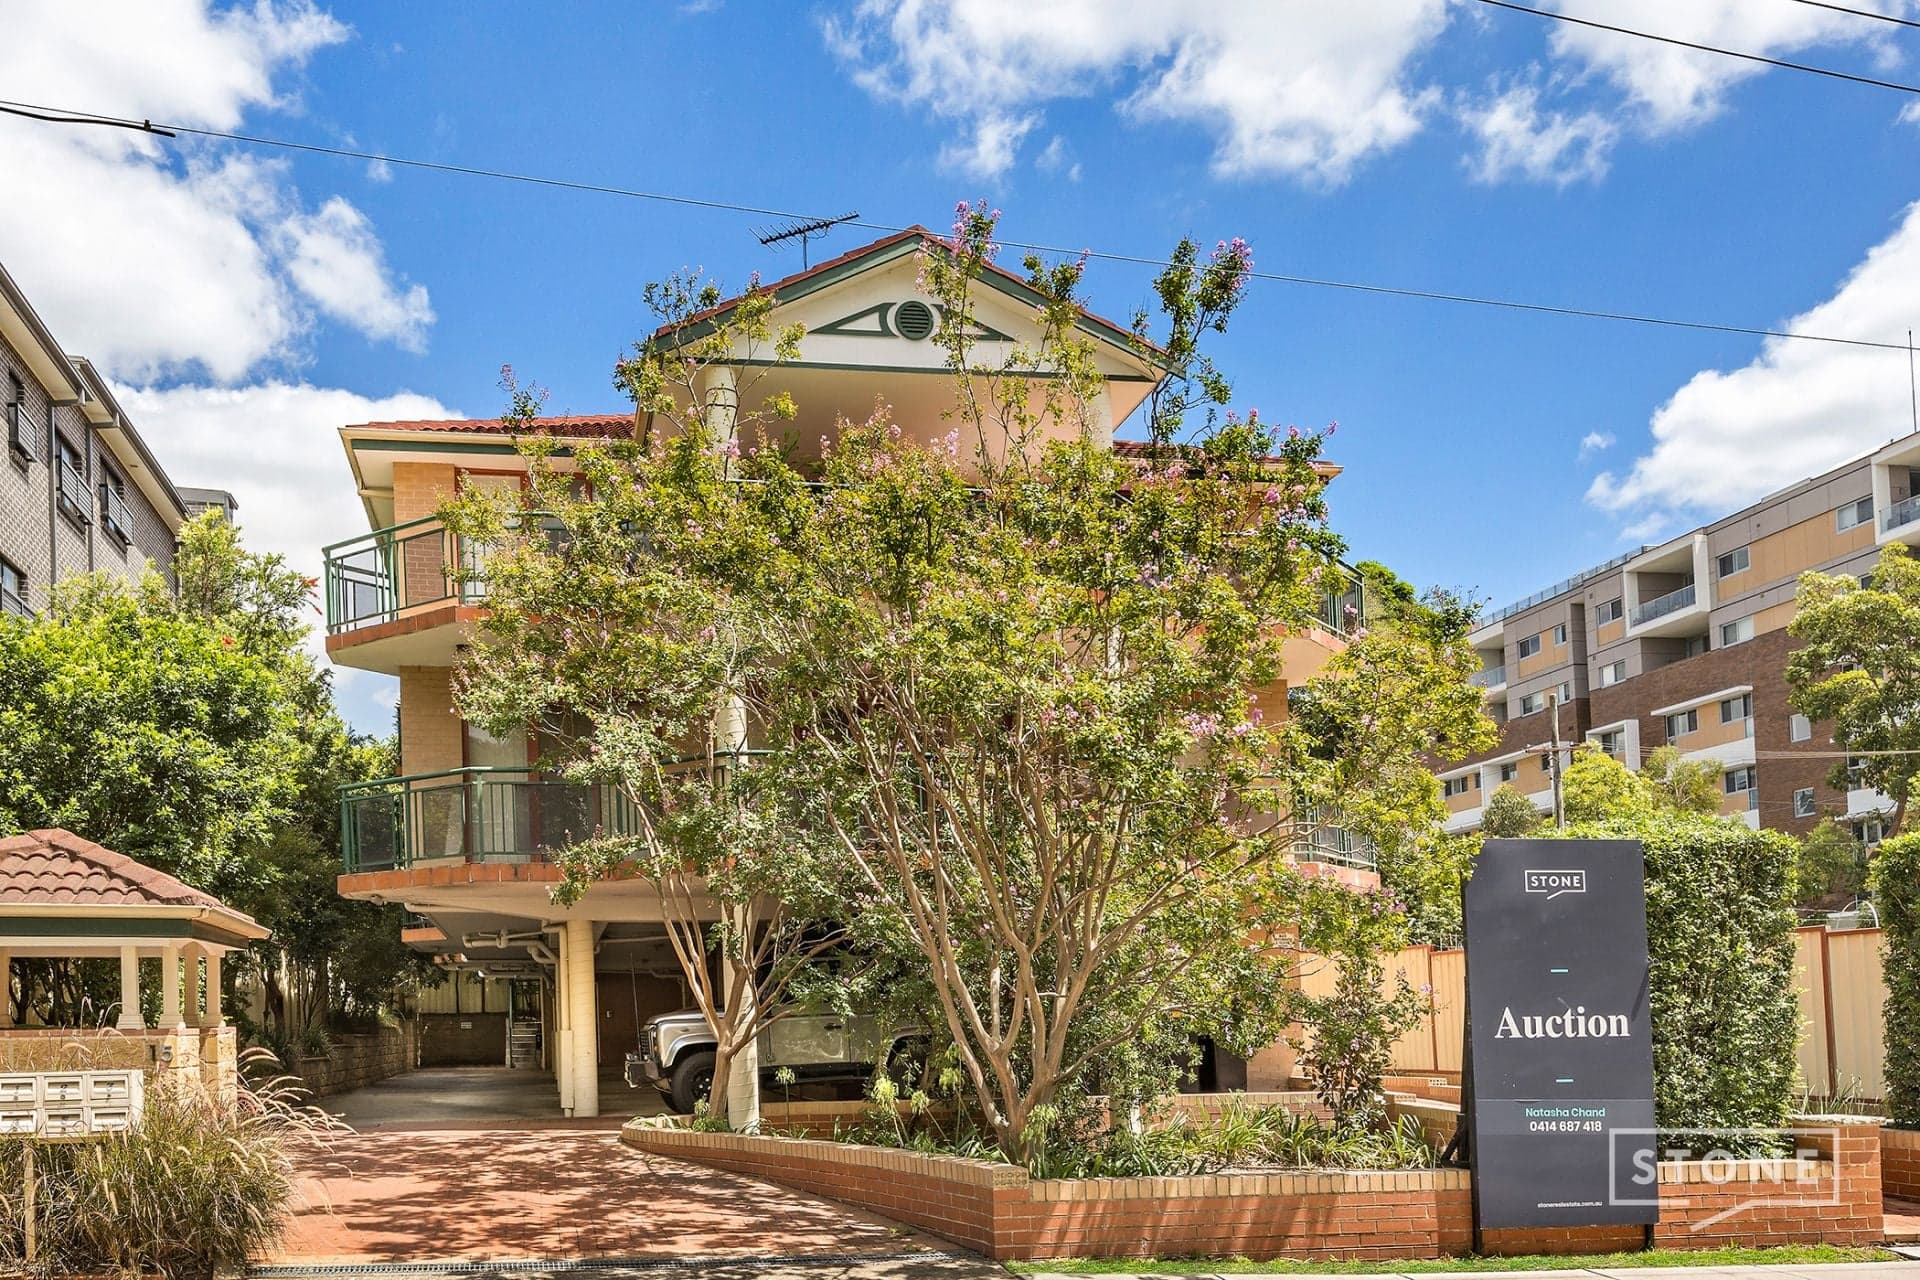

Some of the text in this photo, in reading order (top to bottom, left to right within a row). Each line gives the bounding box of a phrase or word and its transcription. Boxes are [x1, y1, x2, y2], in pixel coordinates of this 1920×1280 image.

[1530, 875, 1581, 888] STONE
[1494, 1005, 1631, 1039] Auction
[1525, 1107, 1606, 1118] Natasha Chand
[1529, 1121, 1602, 1132] 0414 687 418
